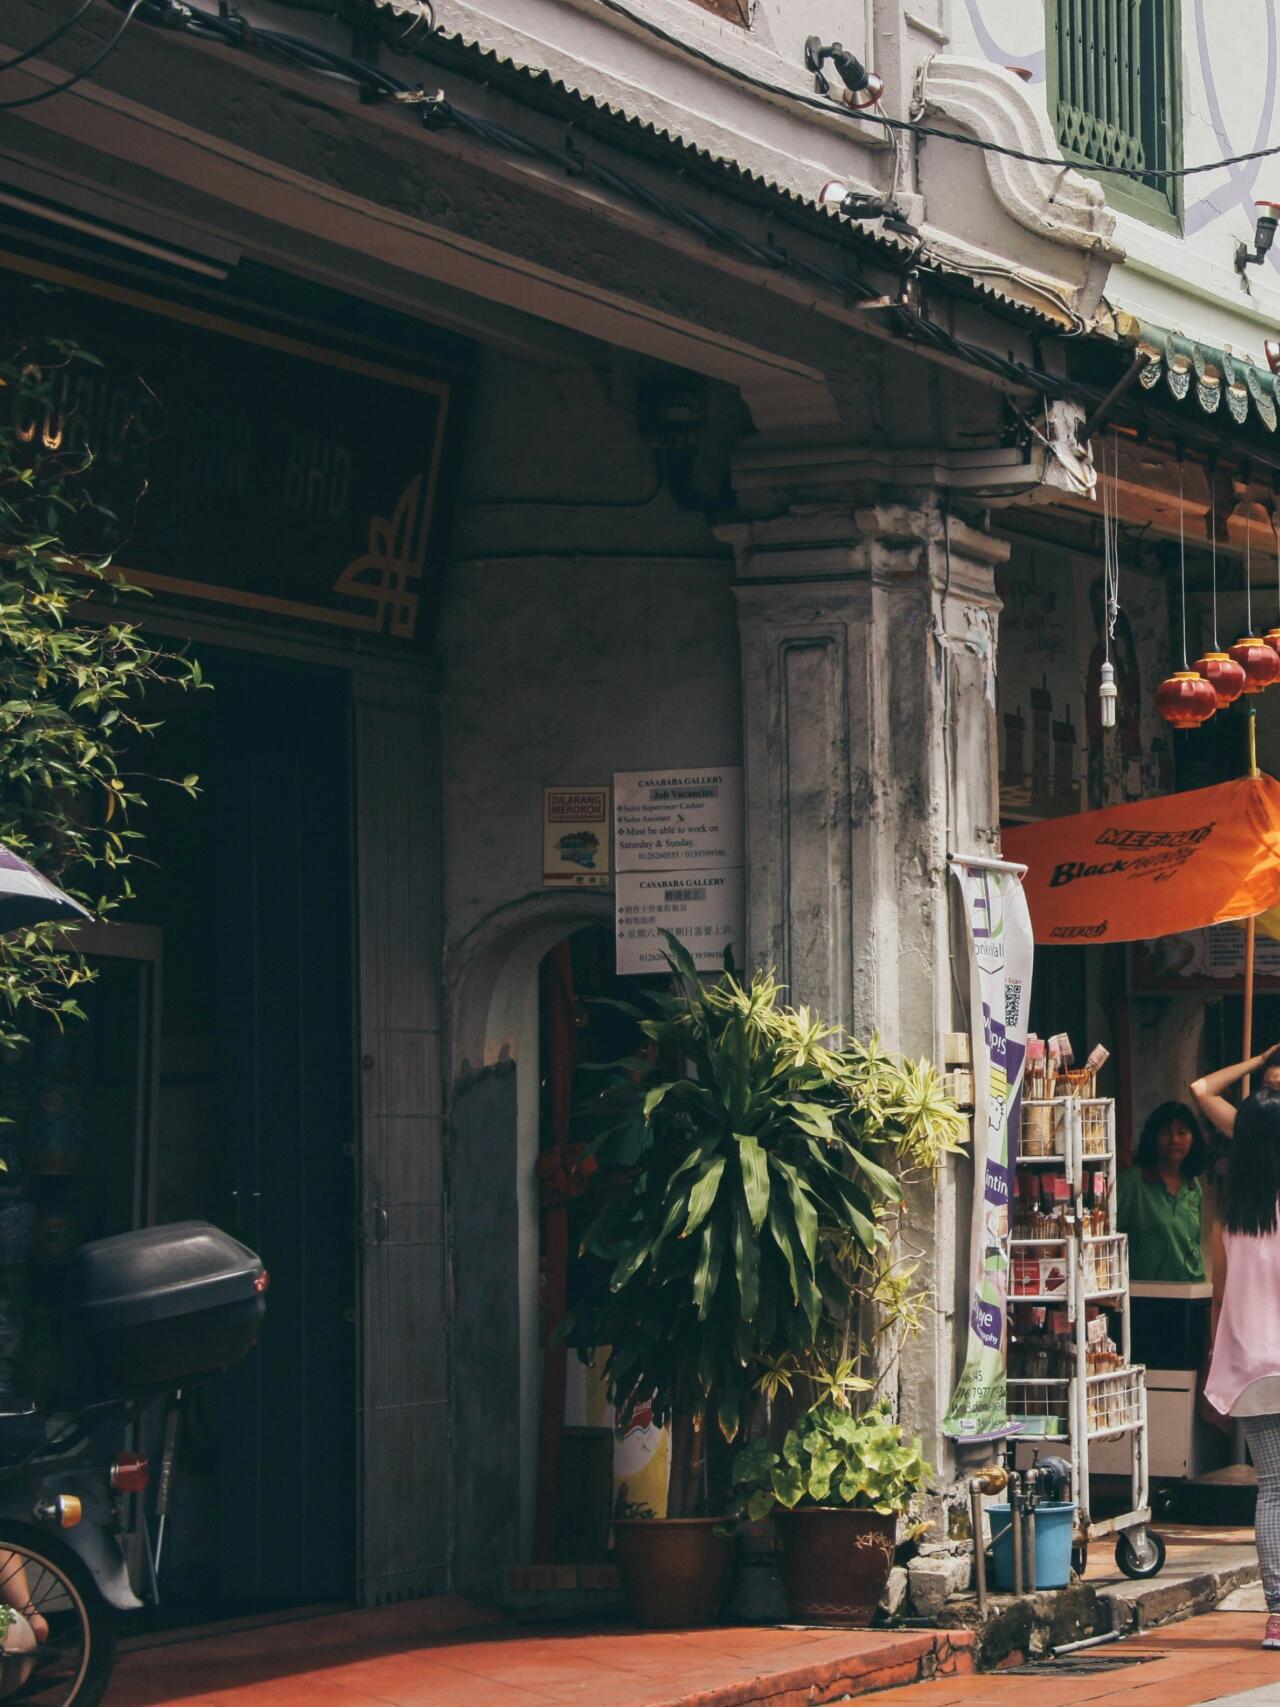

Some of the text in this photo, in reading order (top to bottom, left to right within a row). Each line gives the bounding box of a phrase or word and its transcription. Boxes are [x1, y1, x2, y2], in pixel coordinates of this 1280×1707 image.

[684, 776, 723, 785] GALLERY
[654, 789, 714, 799] Job Vacancies
[552, 795, 601, 805] DILARANG
[552, 805, 601, 815] MEROKOK
[626, 828, 646, 836] Must
[648, 826, 657, 835] be
[659, 825, 675, 834] able
[687, 825, 707, 833] work
[619, 840, 653, 850] Saturday
[1049, 860, 1130, 888] Black
[640, 878, 724, 889] CASABABA GALLERY
